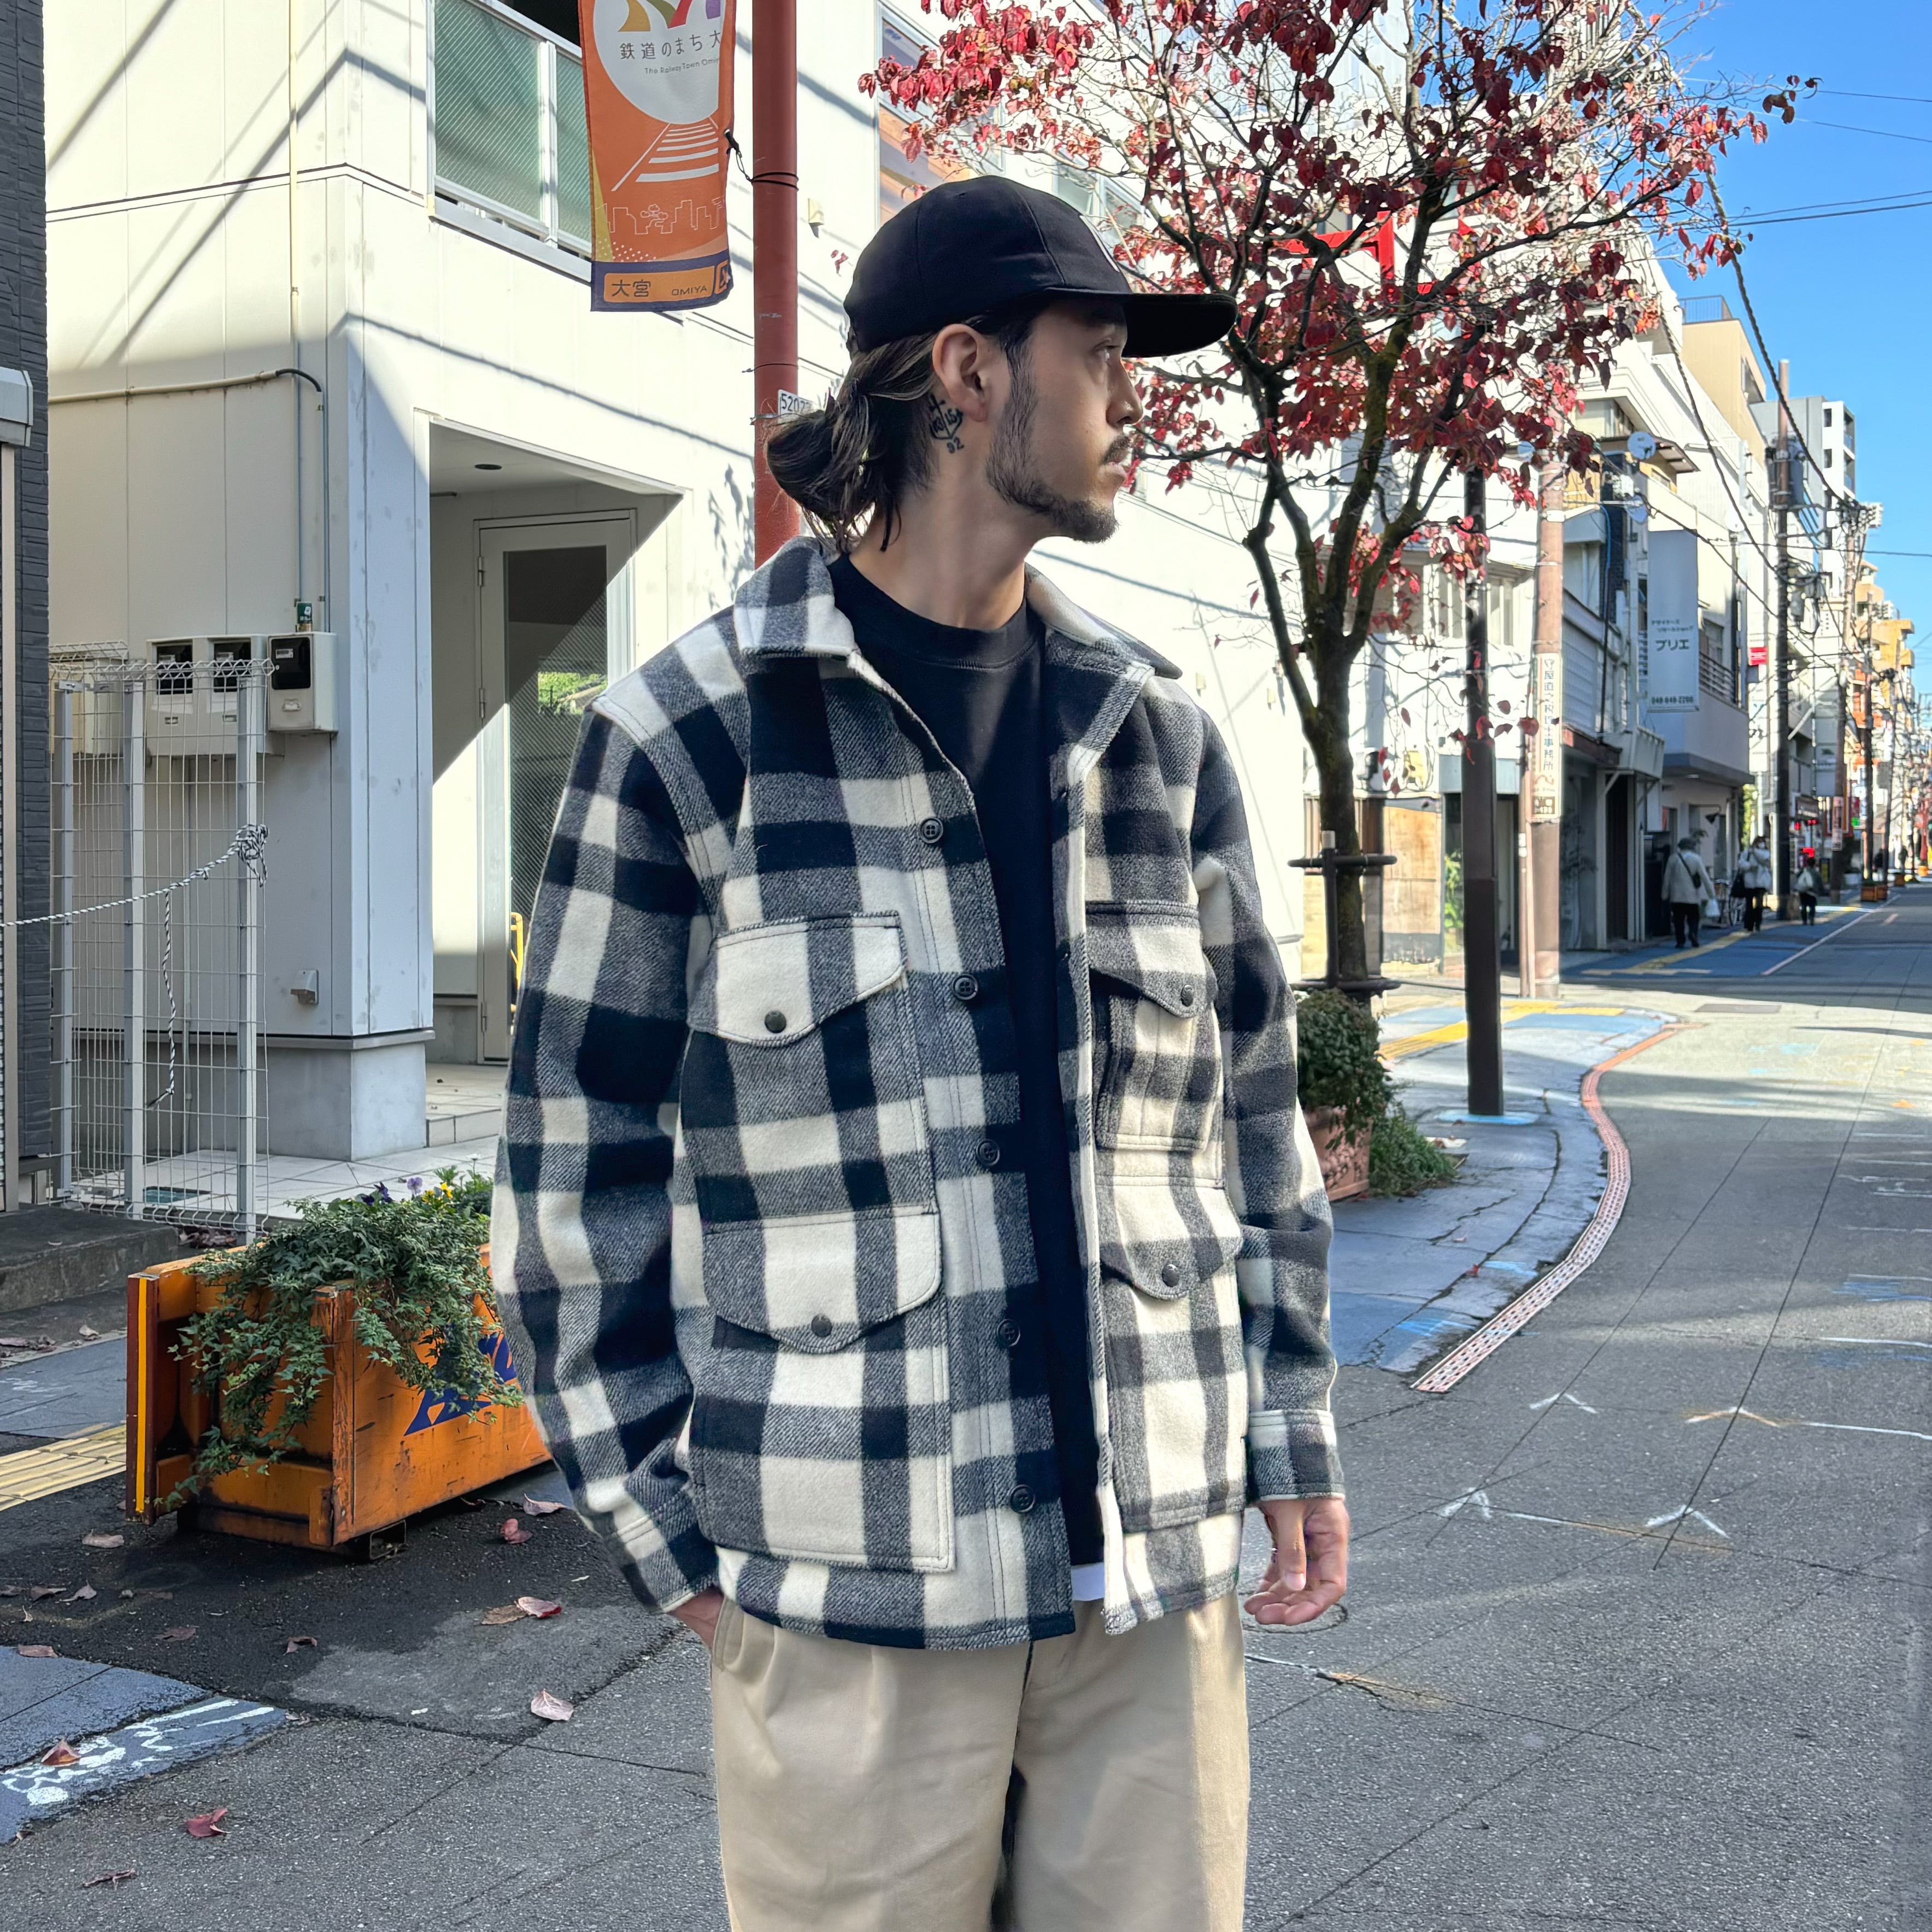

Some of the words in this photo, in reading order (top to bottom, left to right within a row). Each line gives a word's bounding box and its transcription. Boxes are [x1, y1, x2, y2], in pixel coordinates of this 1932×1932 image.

[682, 61, 700, 69] Town
[612, 279, 651, 297] 大宮
[671, 285, 707, 296] OMIYA
